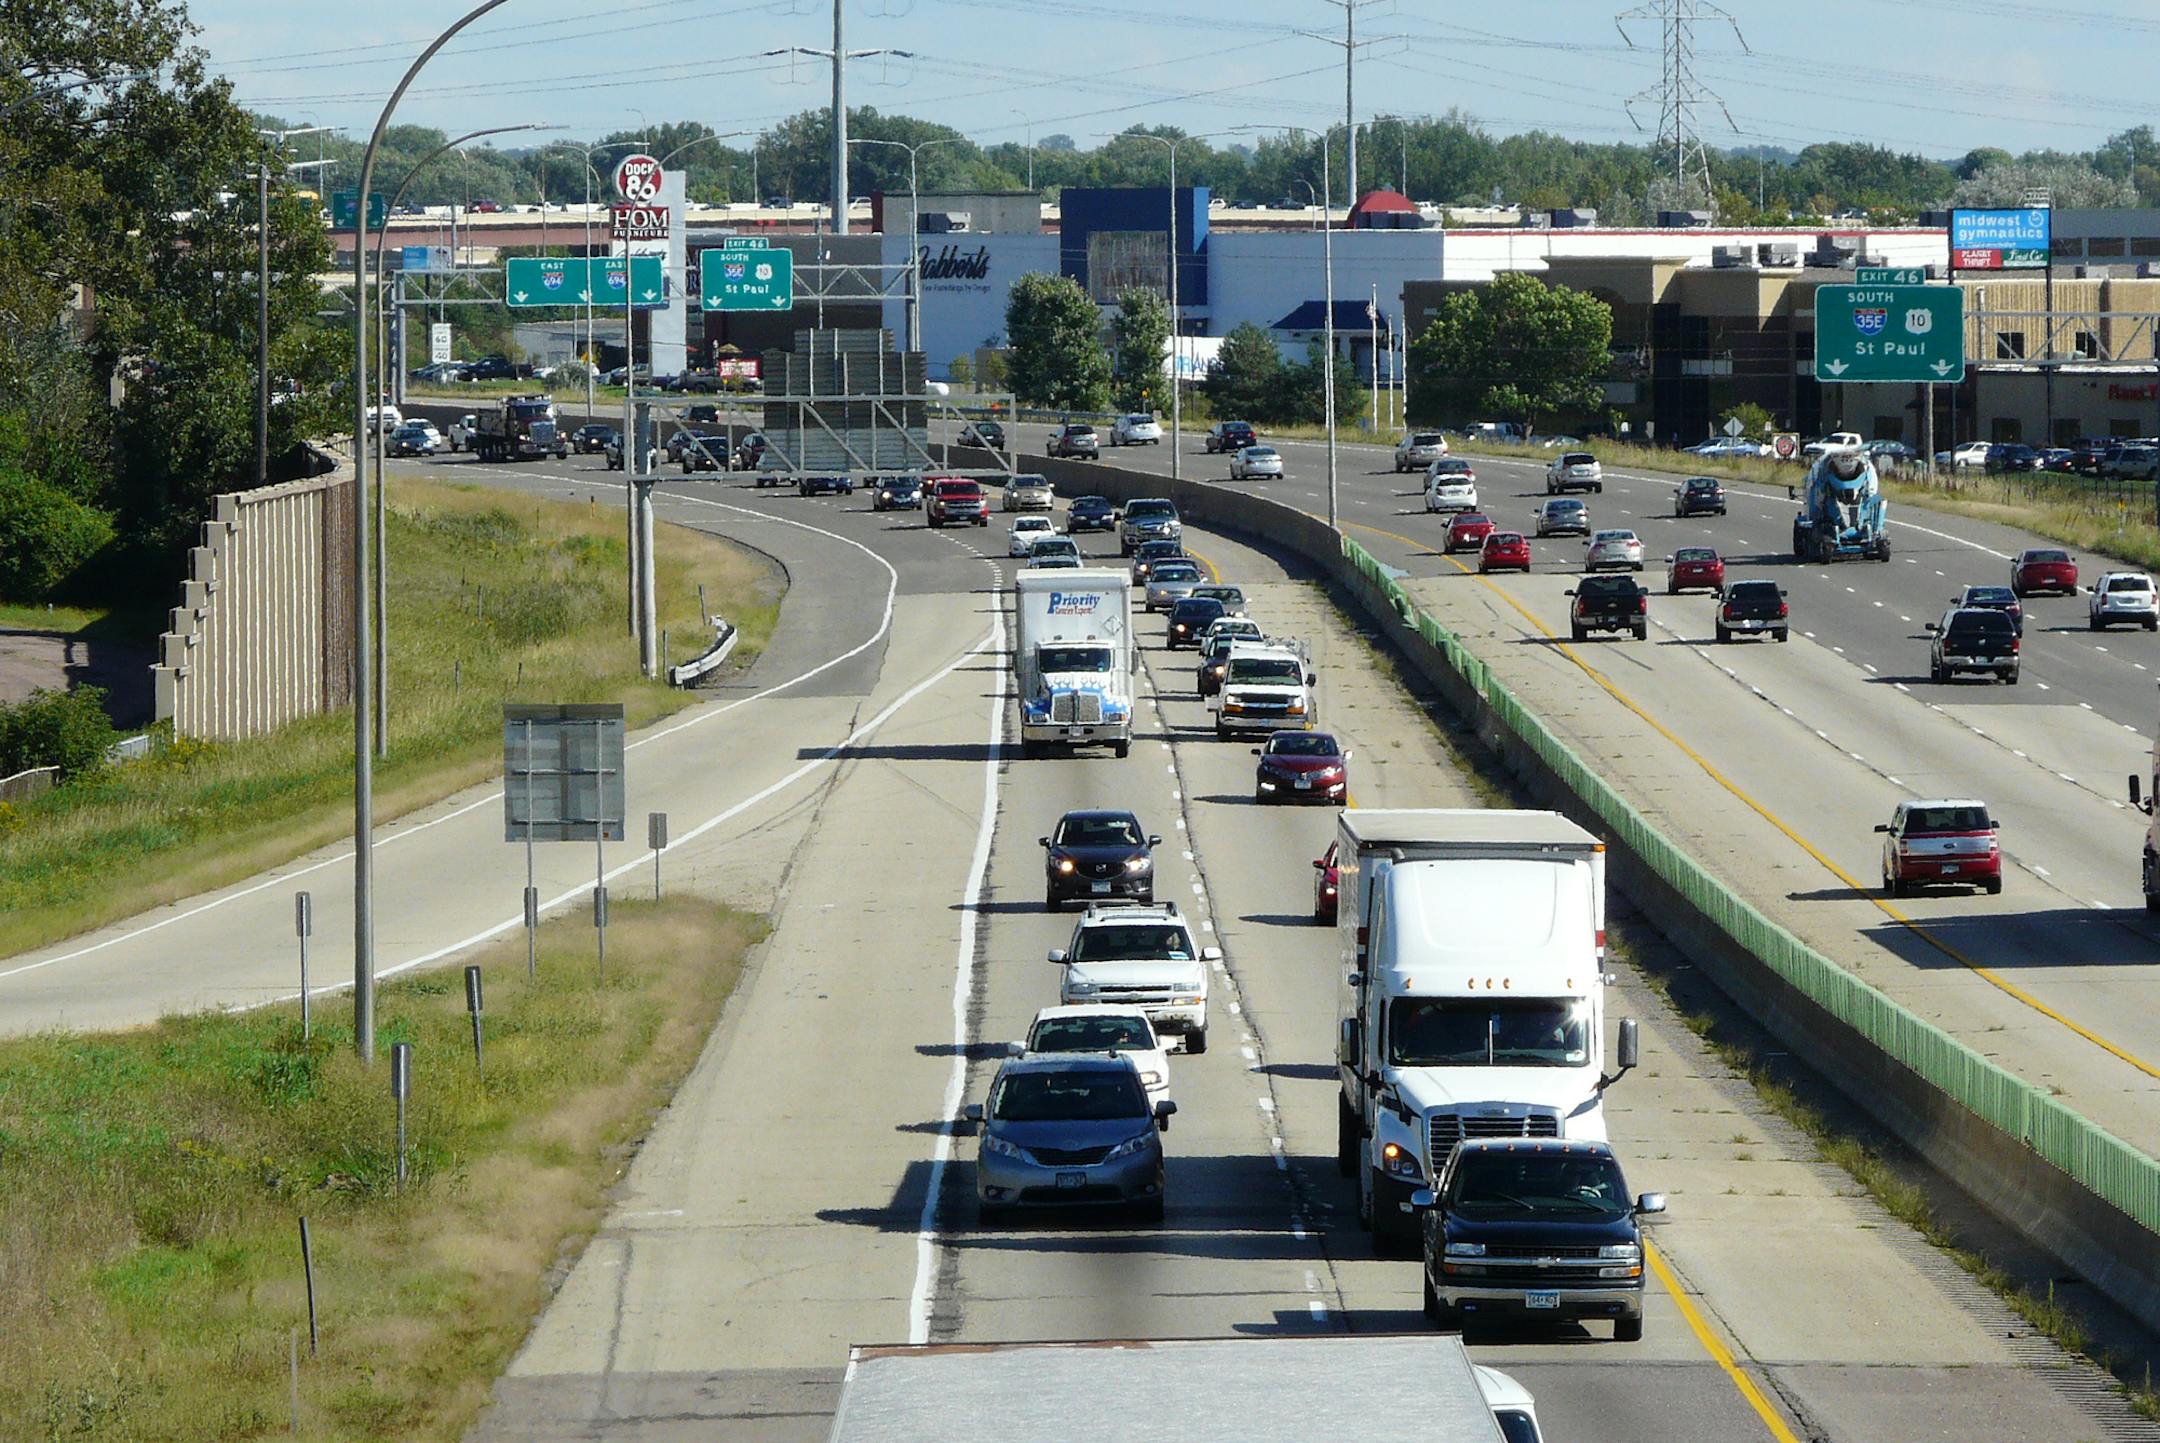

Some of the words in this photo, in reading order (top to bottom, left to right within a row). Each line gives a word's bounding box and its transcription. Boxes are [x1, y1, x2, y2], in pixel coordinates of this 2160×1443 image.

[625, 163, 655, 176] DOCK
[626, 175, 657, 200] 86
[614, 209, 668, 228] HOM
[1959, 215, 2020, 226] midwest
[1959, 228, 2044, 240] gymnastics
[728, 240, 746, 248] EXIT
[749, 240, 764, 248] 46
[540, 262, 565, 270] EAST
[1861, 271, 1889, 282] EXIT
[1894, 271, 1918, 284] 46
[725, 284, 738, 294] St
[743, 284, 769, 294] Paul
[1848, 292, 1894, 303] SOUTH
[1856, 315, 1883, 328] 35E
[1911, 314, 1926, 327] 10
[1856, 342, 1874, 355] St
[1884, 342, 1926, 355] Paul
[1047, 592, 1100, 614] Priority
